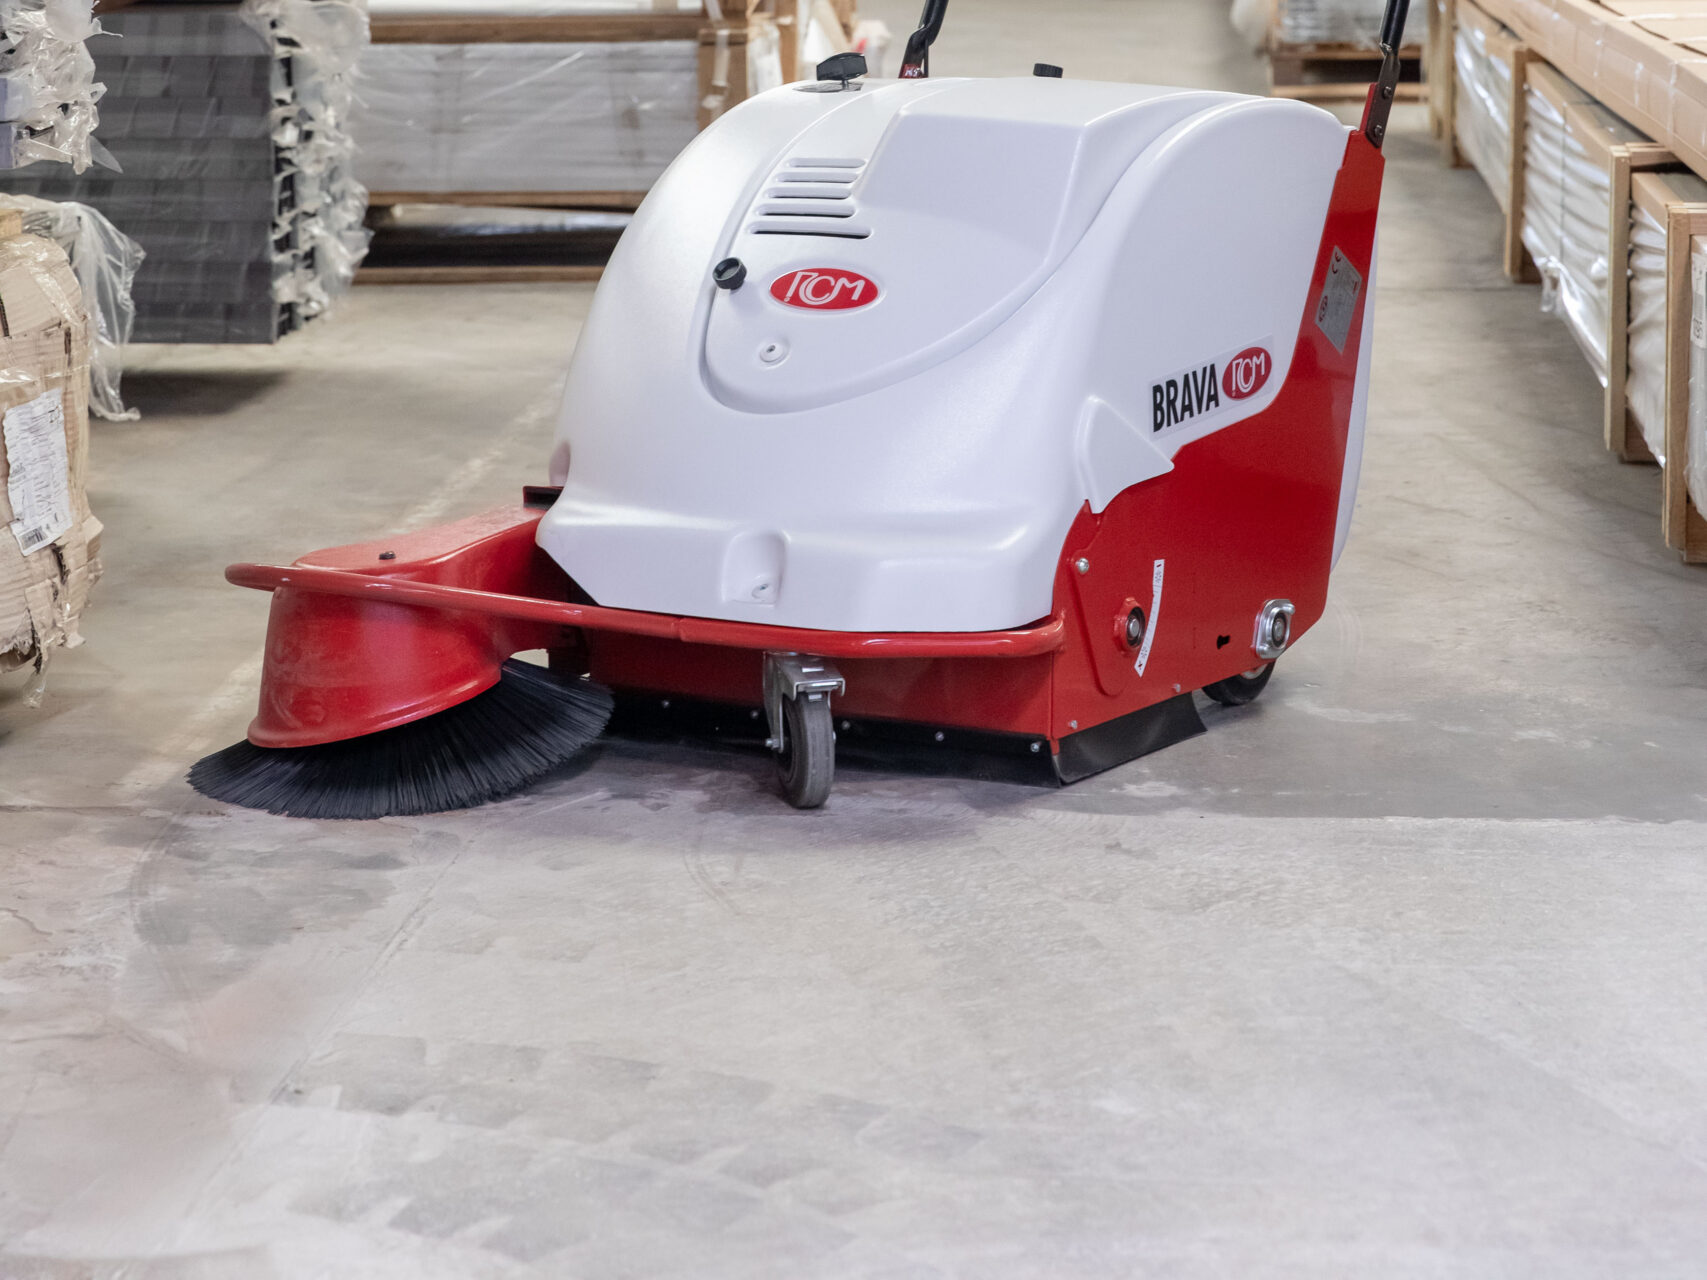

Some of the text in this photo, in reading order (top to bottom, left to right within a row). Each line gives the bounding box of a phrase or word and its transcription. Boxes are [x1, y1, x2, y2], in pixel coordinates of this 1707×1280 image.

[783, 271, 867, 306] RCM
[1152, 351, 1268, 433] BRAVA RCM
